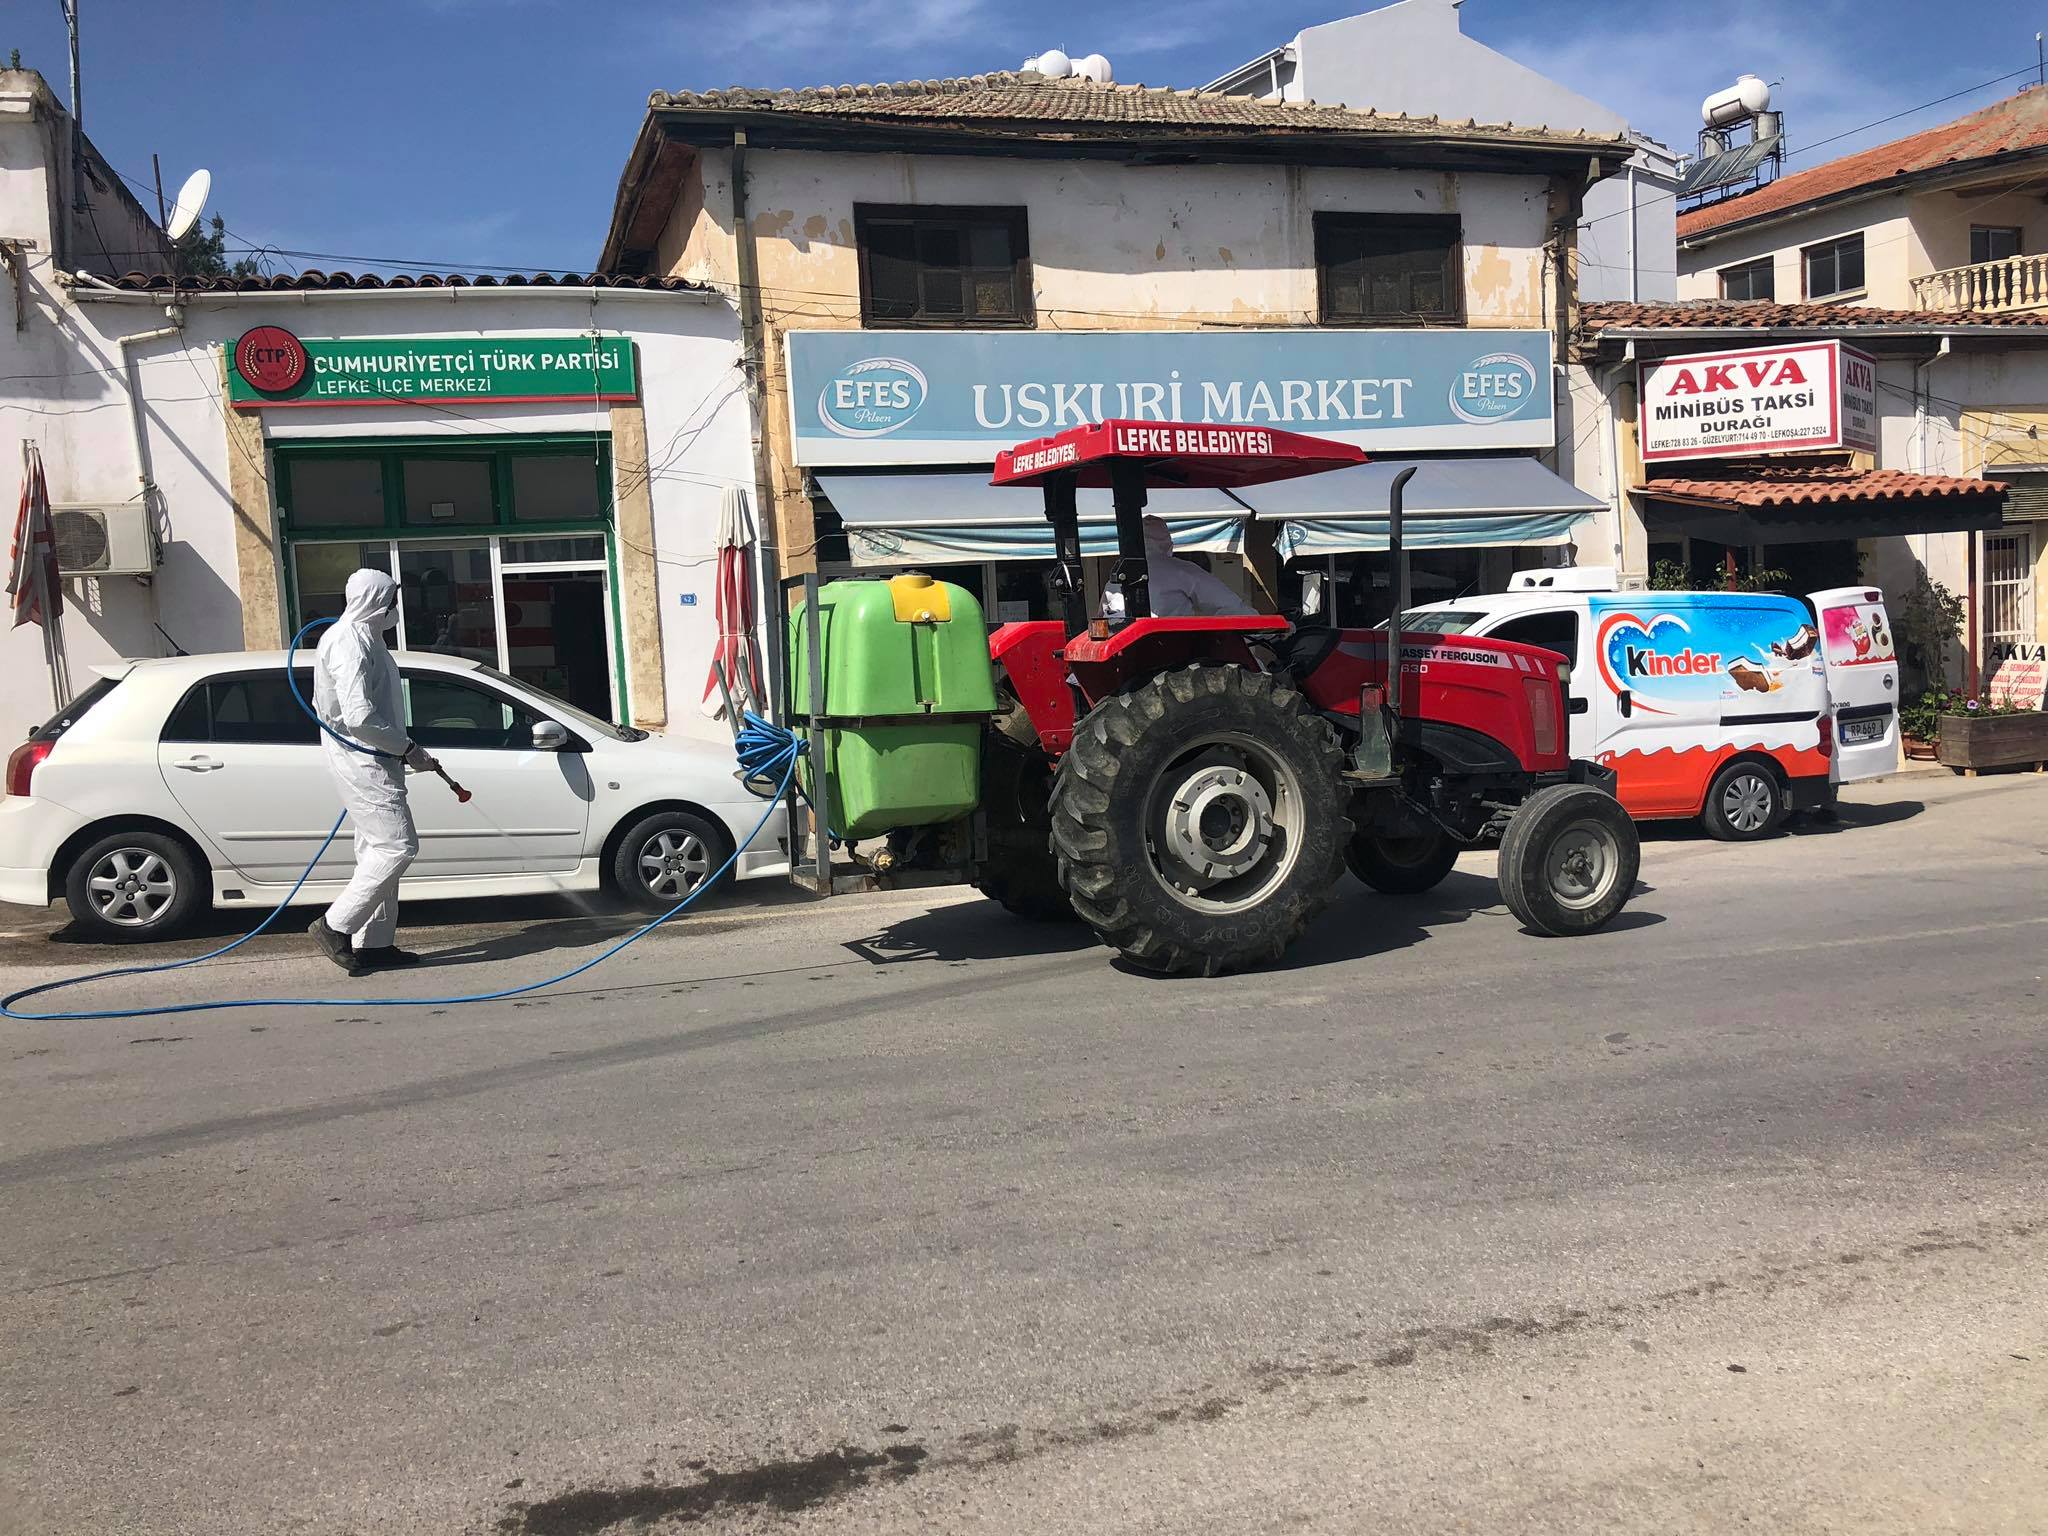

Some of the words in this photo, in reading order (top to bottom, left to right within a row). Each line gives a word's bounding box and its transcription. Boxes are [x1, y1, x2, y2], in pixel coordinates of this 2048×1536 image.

[255, 348, 286, 364] CTP
[314, 350, 475, 374] CUMHURİYETÇİ
[479, 349, 536, 371] TÜRK
[541, 348, 619, 370] PARTİSİ
[317, 379, 370, 395] LEFKE
[377, 377, 413, 395] İLÇE
[420, 375, 492, 393] MERKEZİ
[1463, 372, 1522, 398] EFES
[1666, 357, 1808, 397] AKVA
[1845, 359, 1872, 393] AKVA
[834, 379, 911, 409] EFES
[972, 370, 1184, 429] USKURİ
[1200, 378, 1414, 423] MARKET
[1477, 398, 1507, 411] Pilsen
[1655, 397, 1744, 421] MİNİBÜS
[1751, 388, 1815, 411] TAKSİ
[854, 408, 892, 424] Pilsen
[1700, 415, 1772, 434] DURAĞI
[1116, 428, 1172, 452] LEFKE
[1175, 429, 1273, 454] BELEDİYESİ
[1682, 438, 1690, 447] 83
[1750, 431, 1758, 441] 49
[1759, 431, 1767, 440] 70
[1812, 426, 1827, 436] 2524
[1012, 453, 1034, 474] LEFKE
[1034, 443, 1076, 468] BELEDİYESİ
[1400, 648, 1438, 659] ASSEY
[1440, 651, 1498, 664] FERGUSON
[1626, 646, 1721, 677] Kinder
[1989, 643, 2046, 662] AKVA
